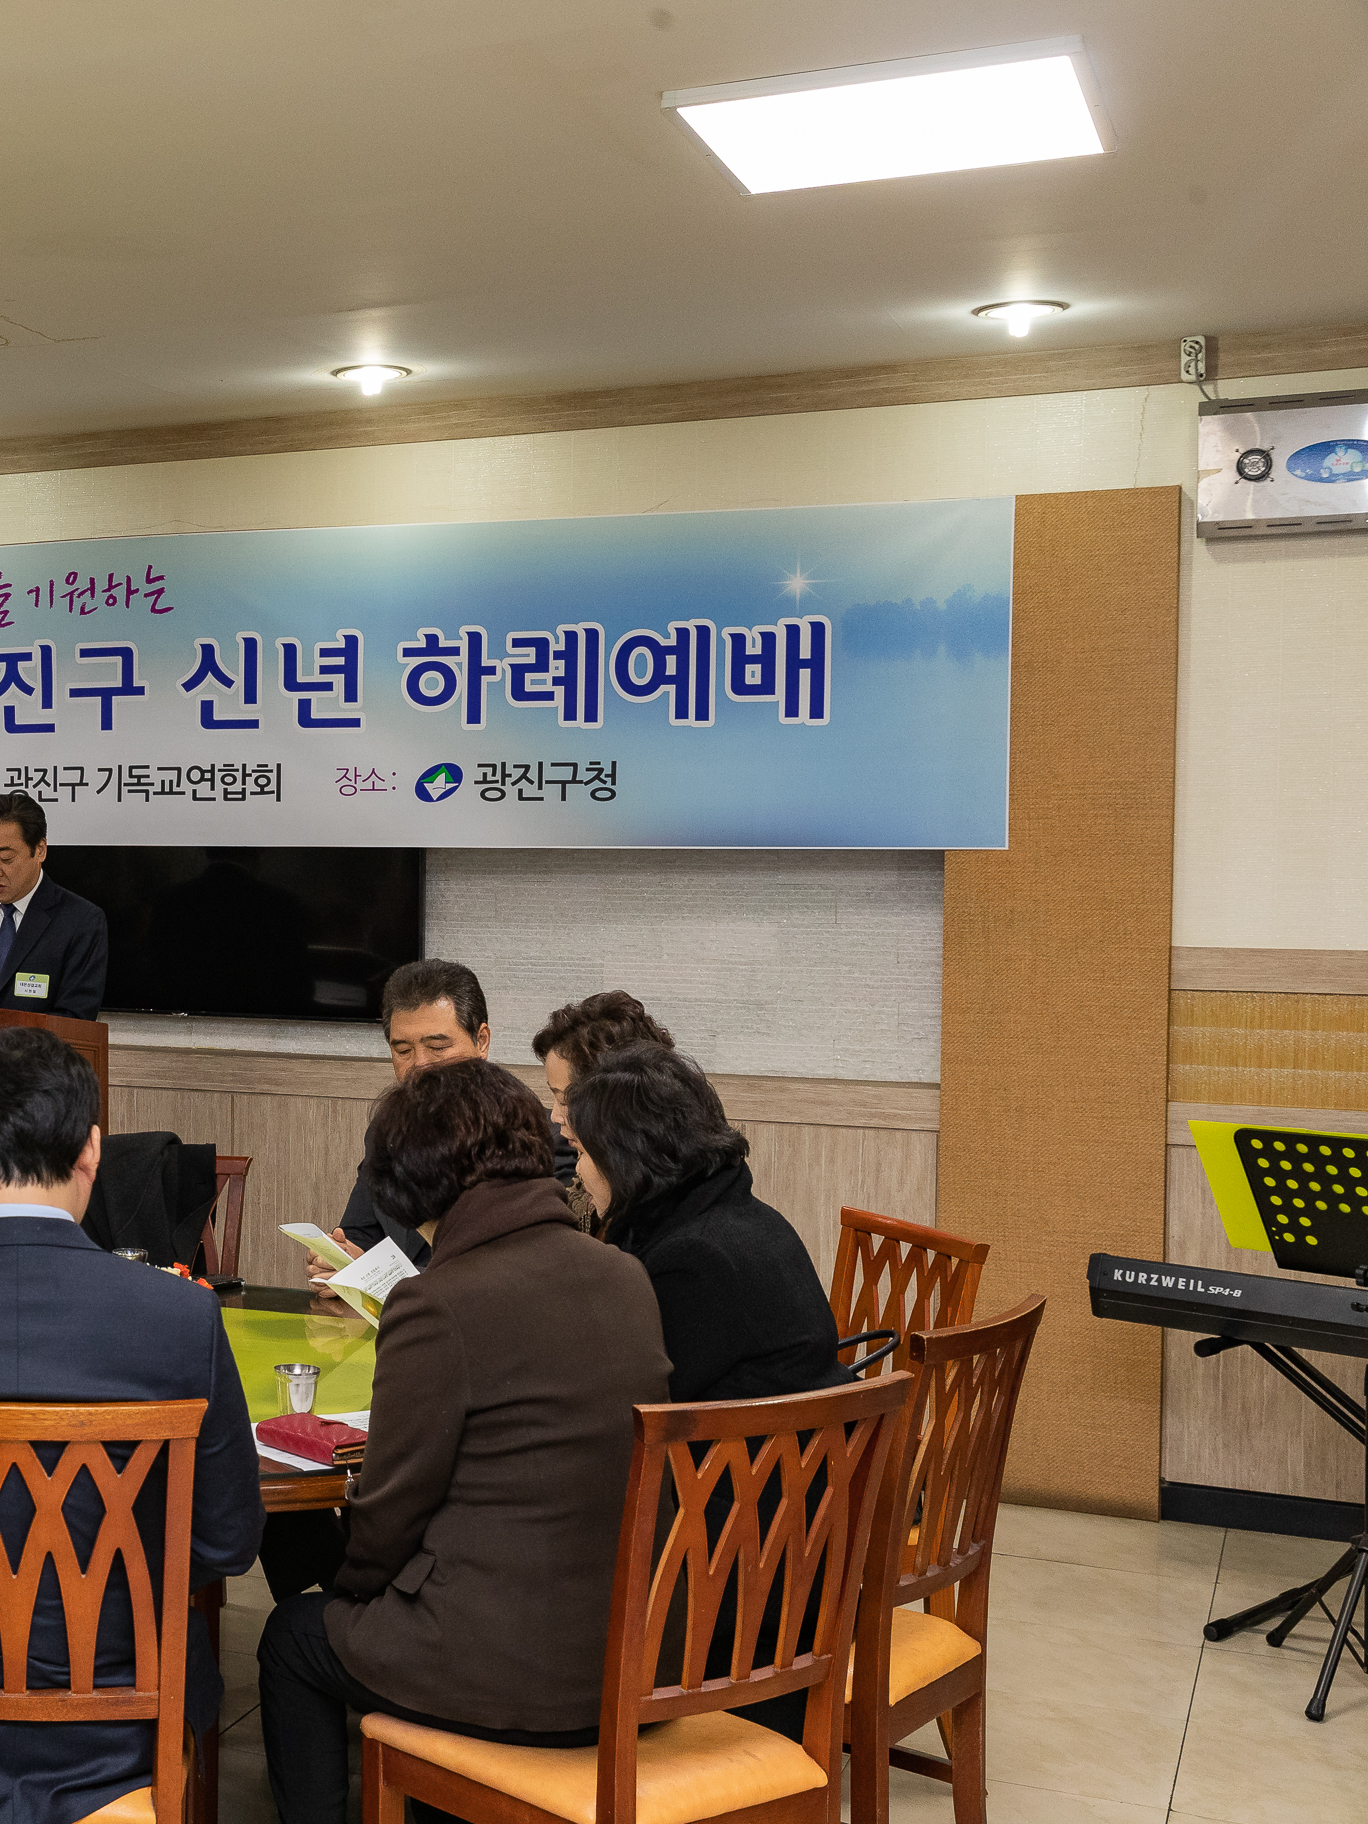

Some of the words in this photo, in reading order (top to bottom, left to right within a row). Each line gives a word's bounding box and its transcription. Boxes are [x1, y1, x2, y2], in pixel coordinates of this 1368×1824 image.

[26, 564, 174, 616] 기원하는
[181, 633, 362, 730] 신년
[401, 620, 826, 725] 하례예배
[3, 765, 90, 803] 광진구
[95, 762, 282, 803] 기독교연합회
[335, 765, 397, 798] 장소:
[473, 760, 618, 803] 광진구청
[1113, 1269, 1205, 1292] KURZWEIL
